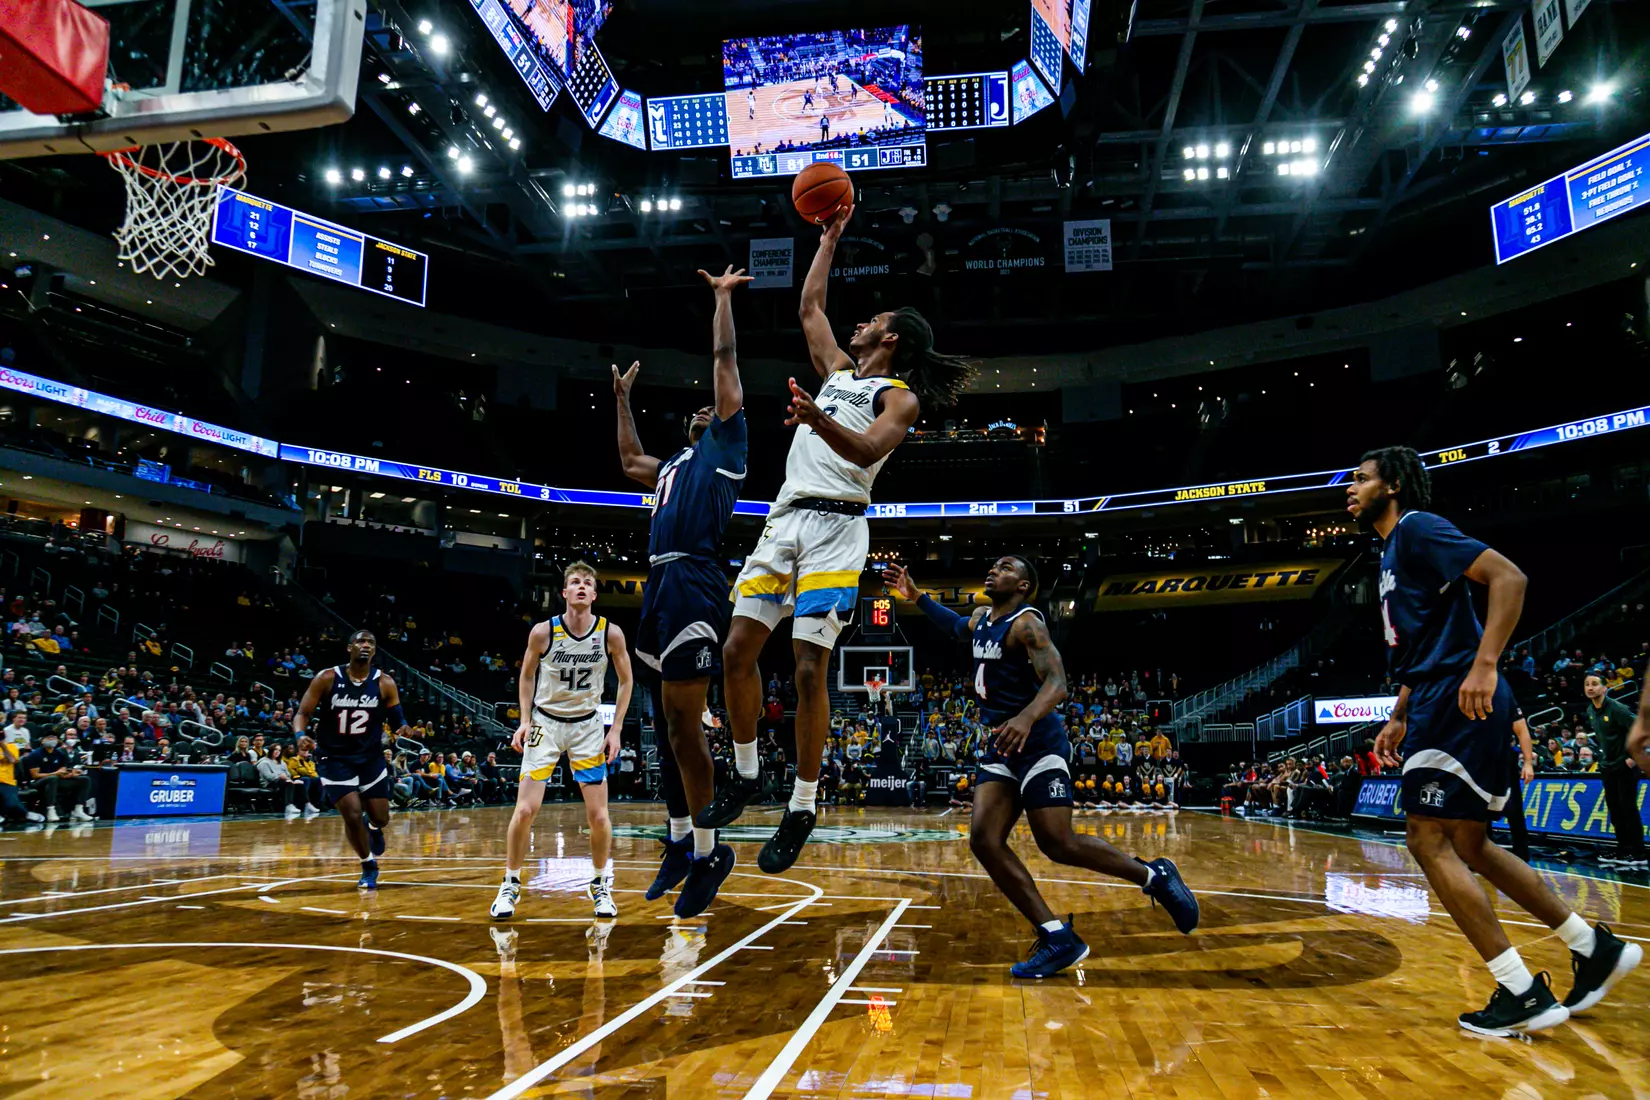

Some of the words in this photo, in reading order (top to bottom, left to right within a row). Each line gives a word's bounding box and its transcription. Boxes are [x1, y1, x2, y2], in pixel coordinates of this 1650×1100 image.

[518, 54, 531, 73] 51
[620, 96, 640, 110] Chill
[787, 158, 804, 170] 81
[852, 154, 869, 166] 51
[1588, 171, 1606, 185] FIELD
[1607, 162, 1625, 176] GOAL
[1581, 187, 1597, 199] 3-PT
[1598, 178, 1616, 192] FIELD
[1617, 170, 1635, 184] GOAL
[236, 194, 273, 211] MARQUETTE
[1508, 186, 1545, 208] MARQUETTE
[1589, 195, 1606, 208] FREE
[1606, 184, 1632, 200] THROW
[250, 212, 260, 220] 21
[1524, 202, 1540, 215] 51.8
[249, 221, 259, 230] 12
[1073, 227, 1102, 237] DIVISION
[247, 241, 257, 249] 17
[316, 232, 341, 245] ASSISTS
[1068, 236, 1108, 246] CHAMPIONS
[1530, 235, 1541, 244] 43
[316, 243, 338, 254] STEALS
[376, 242, 400, 255] JACKSON
[400, 250, 416, 260] STATE
[752, 248, 792, 258] CONFERENCE
[315, 252, 338, 264] BLOCKS
[753, 258, 790, 267] CHAMPIONS
[965, 260, 994, 270] WORLD
[997, 257, 1045, 268] CHAMPIONS
[308, 260, 342, 276] TURNOVERS
[843, 265, 889, 276] CHAMPIONS
[0, 370, 34, 388] Coors
[36, 382, 67, 397] LIGHT
[135, 407, 167, 424] Chill
[192, 421, 221, 438] Coors
[222, 432, 246, 444] LIGHT
[1556, 417, 1608, 440] 10:08
[1613, 410, 1645, 429] PM
[1439, 449, 1466, 464] TOL
[1488, 441, 1500, 455] 2
[308, 451, 351, 468] 10:08
[355, 458, 380, 472] PM
[419, 469, 441, 481] FLS
[452, 474, 467, 486] 10
[499, 482, 521, 494] TOL
[541, 488, 550, 499] 3
[1174, 486, 1225, 500] JACKSON
[1228, 482, 1265, 496] STATE
[874, 505, 906, 516] 1:05
[969, 503, 997, 514] 2nd
[1064, 501, 1080, 512] 51
[1103, 569, 1320, 596] MARQUETTE
[874, 600, 890, 610] 1:05
[873, 610, 888, 626] 16
[552, 650, 602, 666] Marquette
[560, 667, 592, 690] 42
[974, 663, 987, 700] 4
[331, 693, 359, 710] Jackson
[359, 694, 379, 708] State
[1334, 703, 1371, 717] Coors
[1374, 706, 1393, 716] LIG
[338, 709, 369, 734] 12
[870, 777, 907, 791] meijer
[150, 789, 194, 803] GRUBER
[1358, 784, 1397, 805] GRUBER
